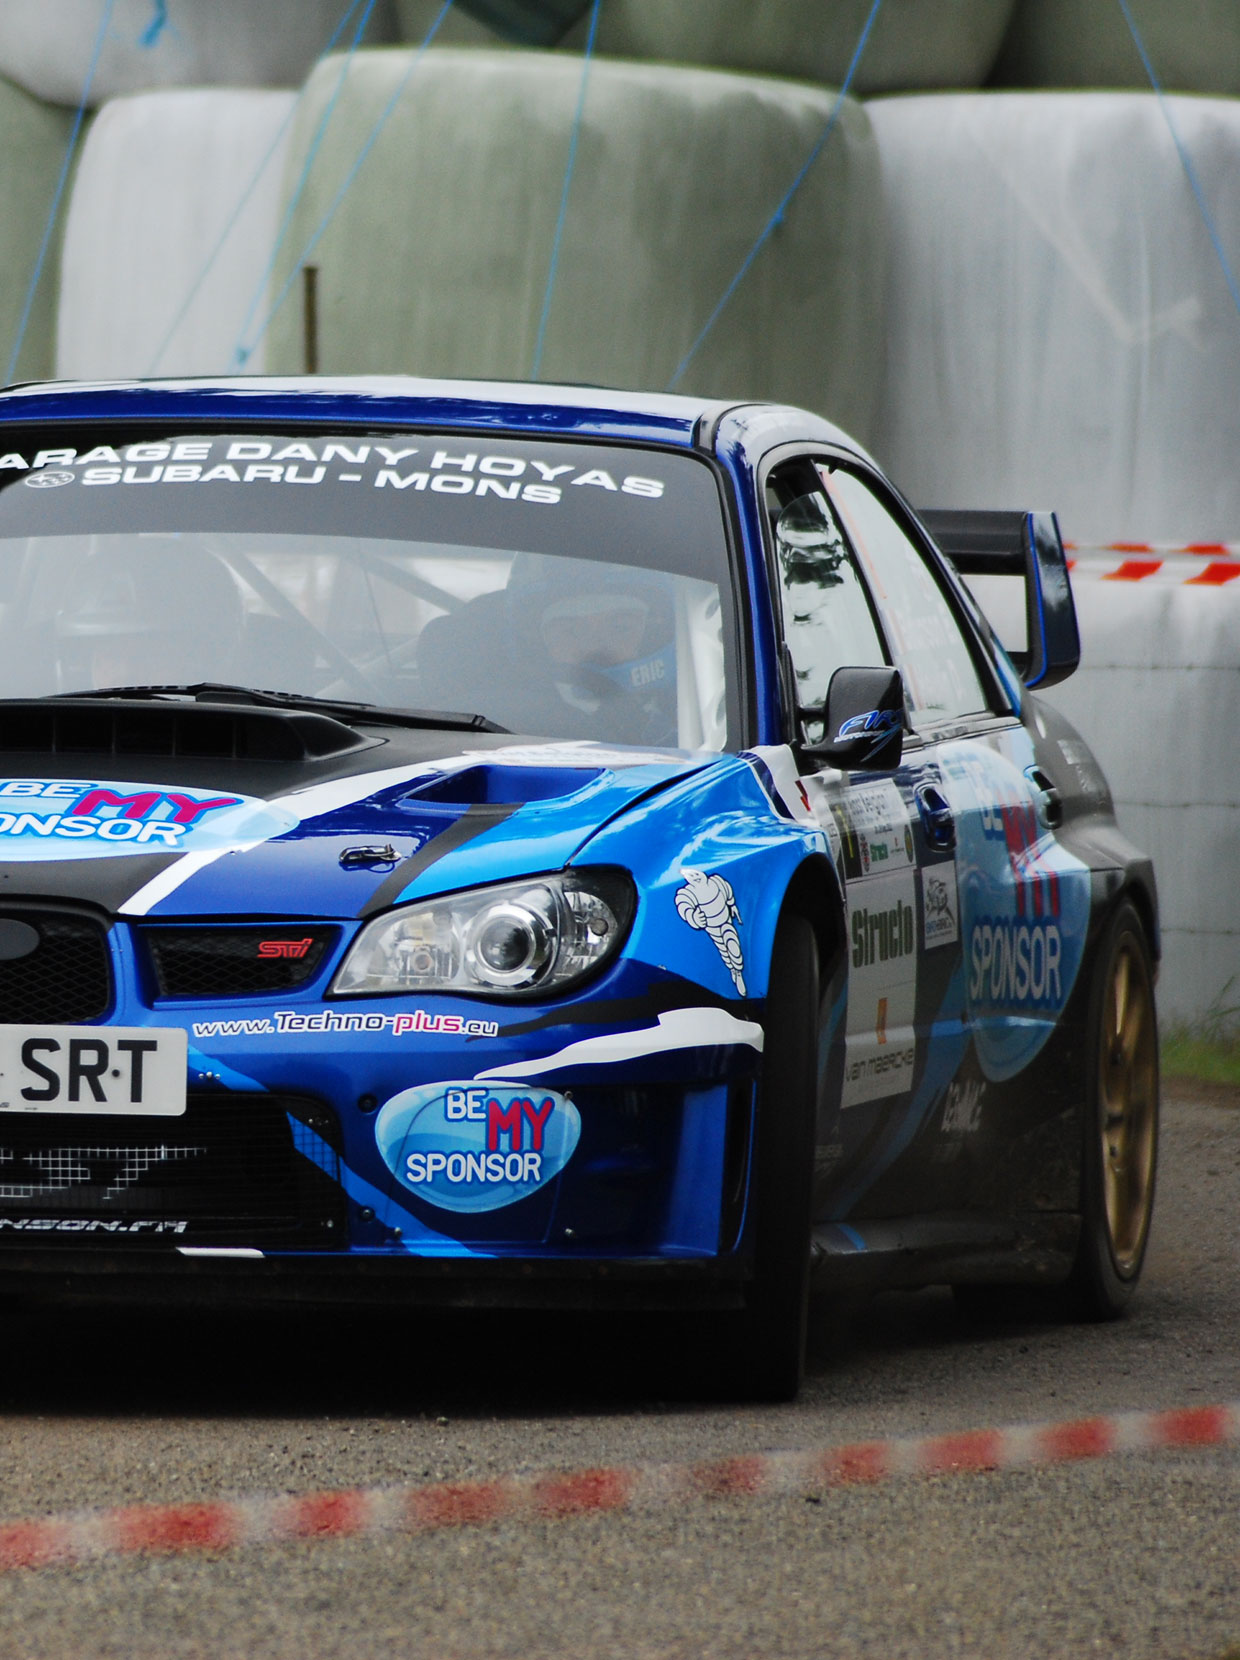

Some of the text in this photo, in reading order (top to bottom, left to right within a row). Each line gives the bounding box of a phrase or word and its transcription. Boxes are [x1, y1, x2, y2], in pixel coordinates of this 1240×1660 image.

[81, 464, 325, 486] SUBARU
[374, 468, 561, 504] MONS
[226, 442, 421, 467] DANY
[429, 451, 665, 499] HOYAS
[631, 658, 665, 688] ERIC
[72, 789, 240, 822] MY
[970, 924, 1062, 1001] SPONSOR
[192, 1010, 498, 1038] www.Techno-plus.eu
[20, 1037, 158, 1103] SRT
[447, 1089, 487, 1120] BE
[487, 1097, 553, 1152] MY
[406, 1152, 541, 1183] SPONSOR
